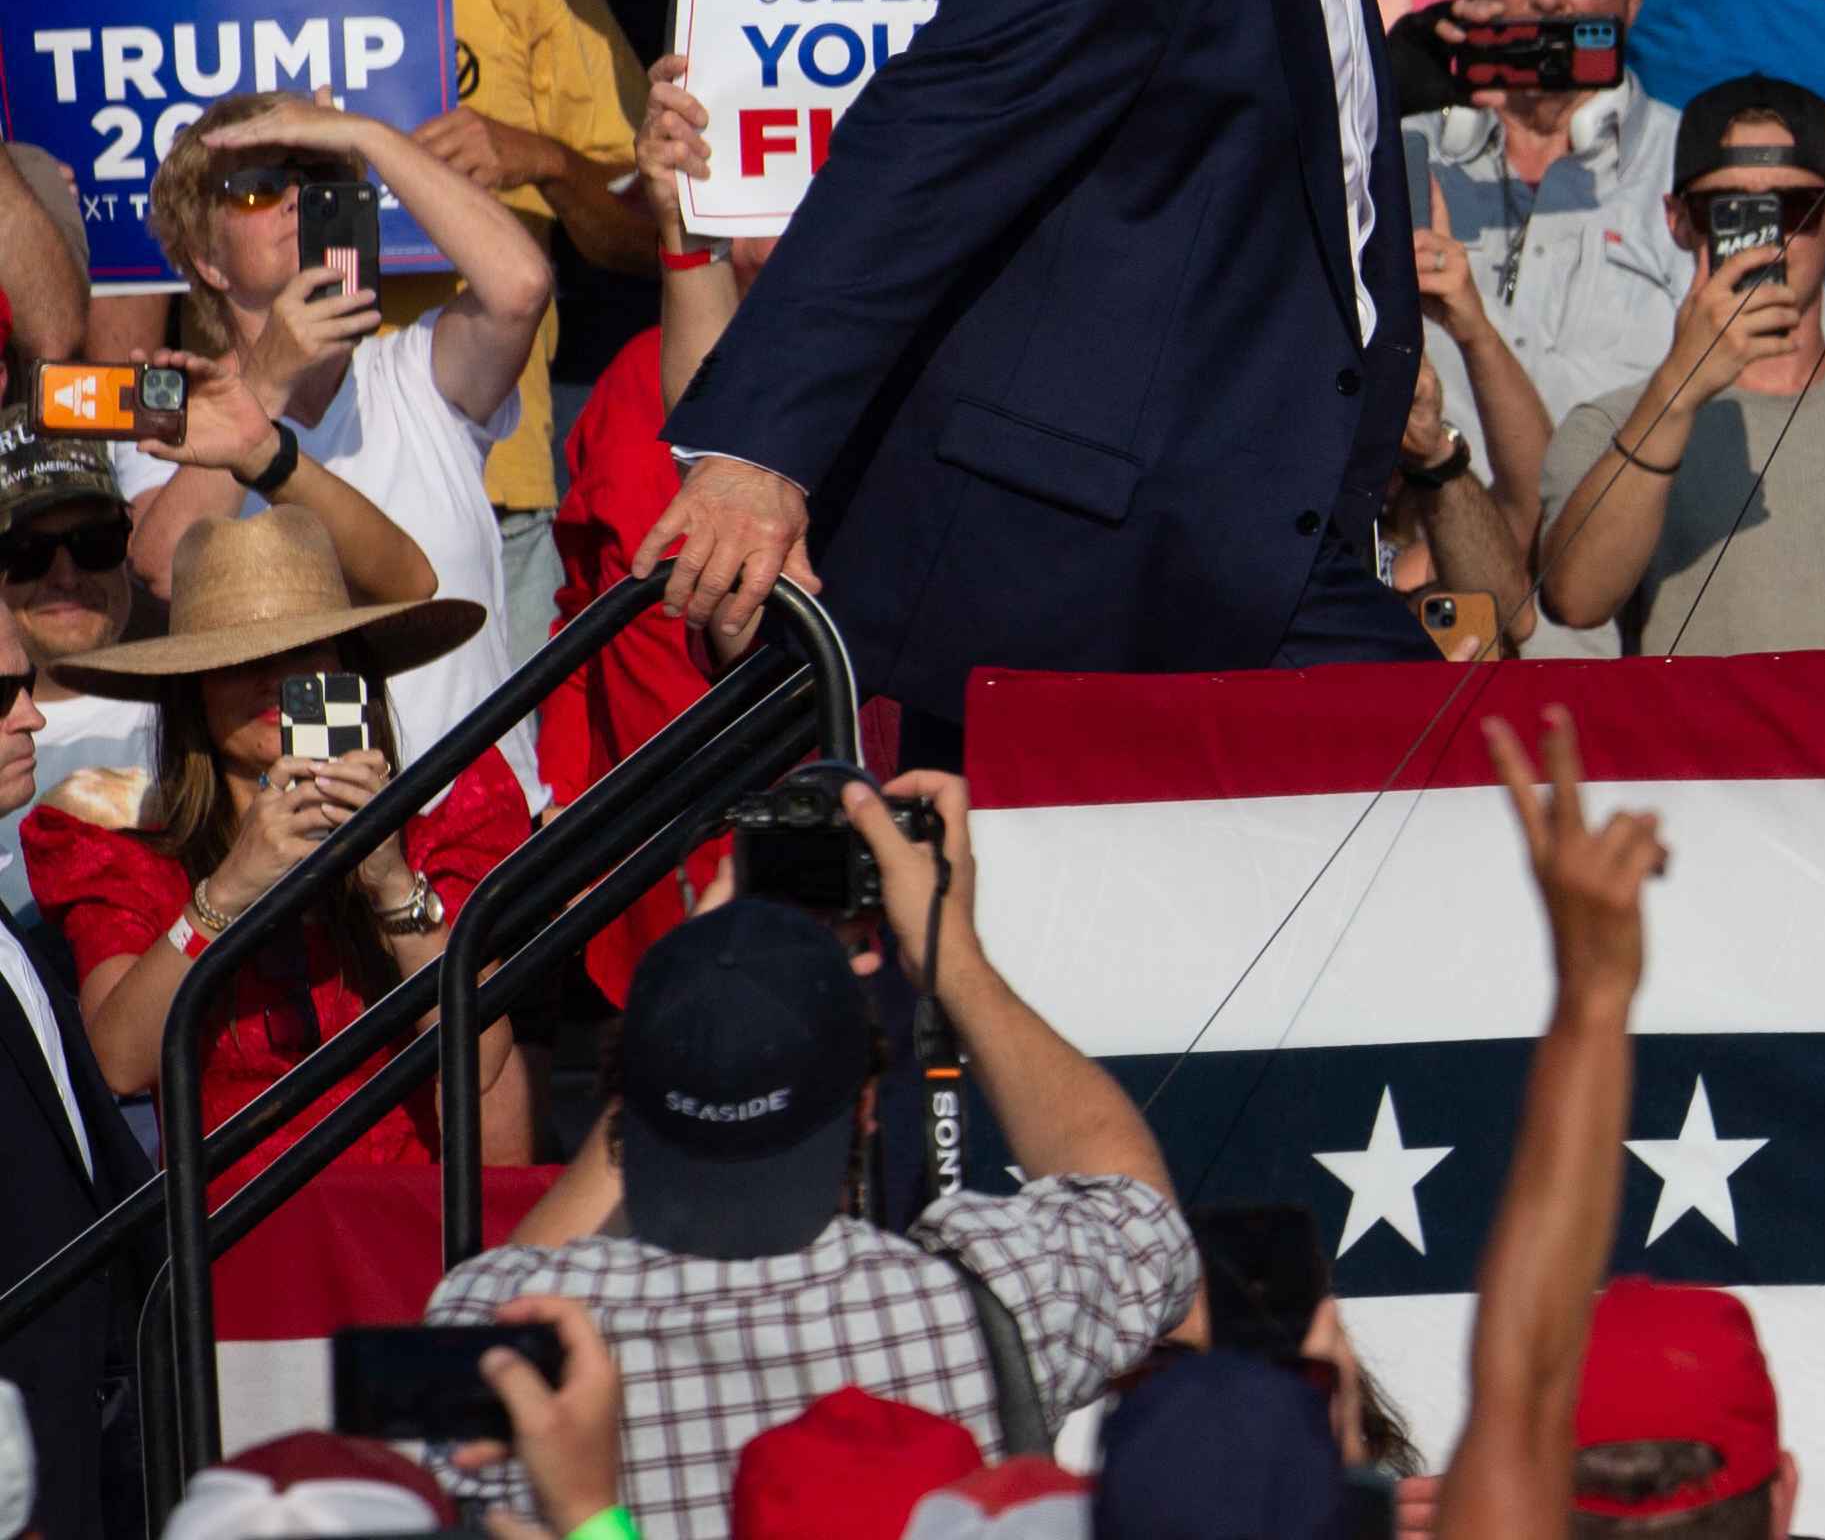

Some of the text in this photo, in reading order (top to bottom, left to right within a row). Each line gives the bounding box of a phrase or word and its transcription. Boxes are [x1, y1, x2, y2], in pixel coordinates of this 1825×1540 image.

[34, 16, 406, 103] TRUMP
[739, 109, 834, 178] FI
[82, 193, 120, 222] XT
[665, 1087, 791, 1123] SEASIDE
